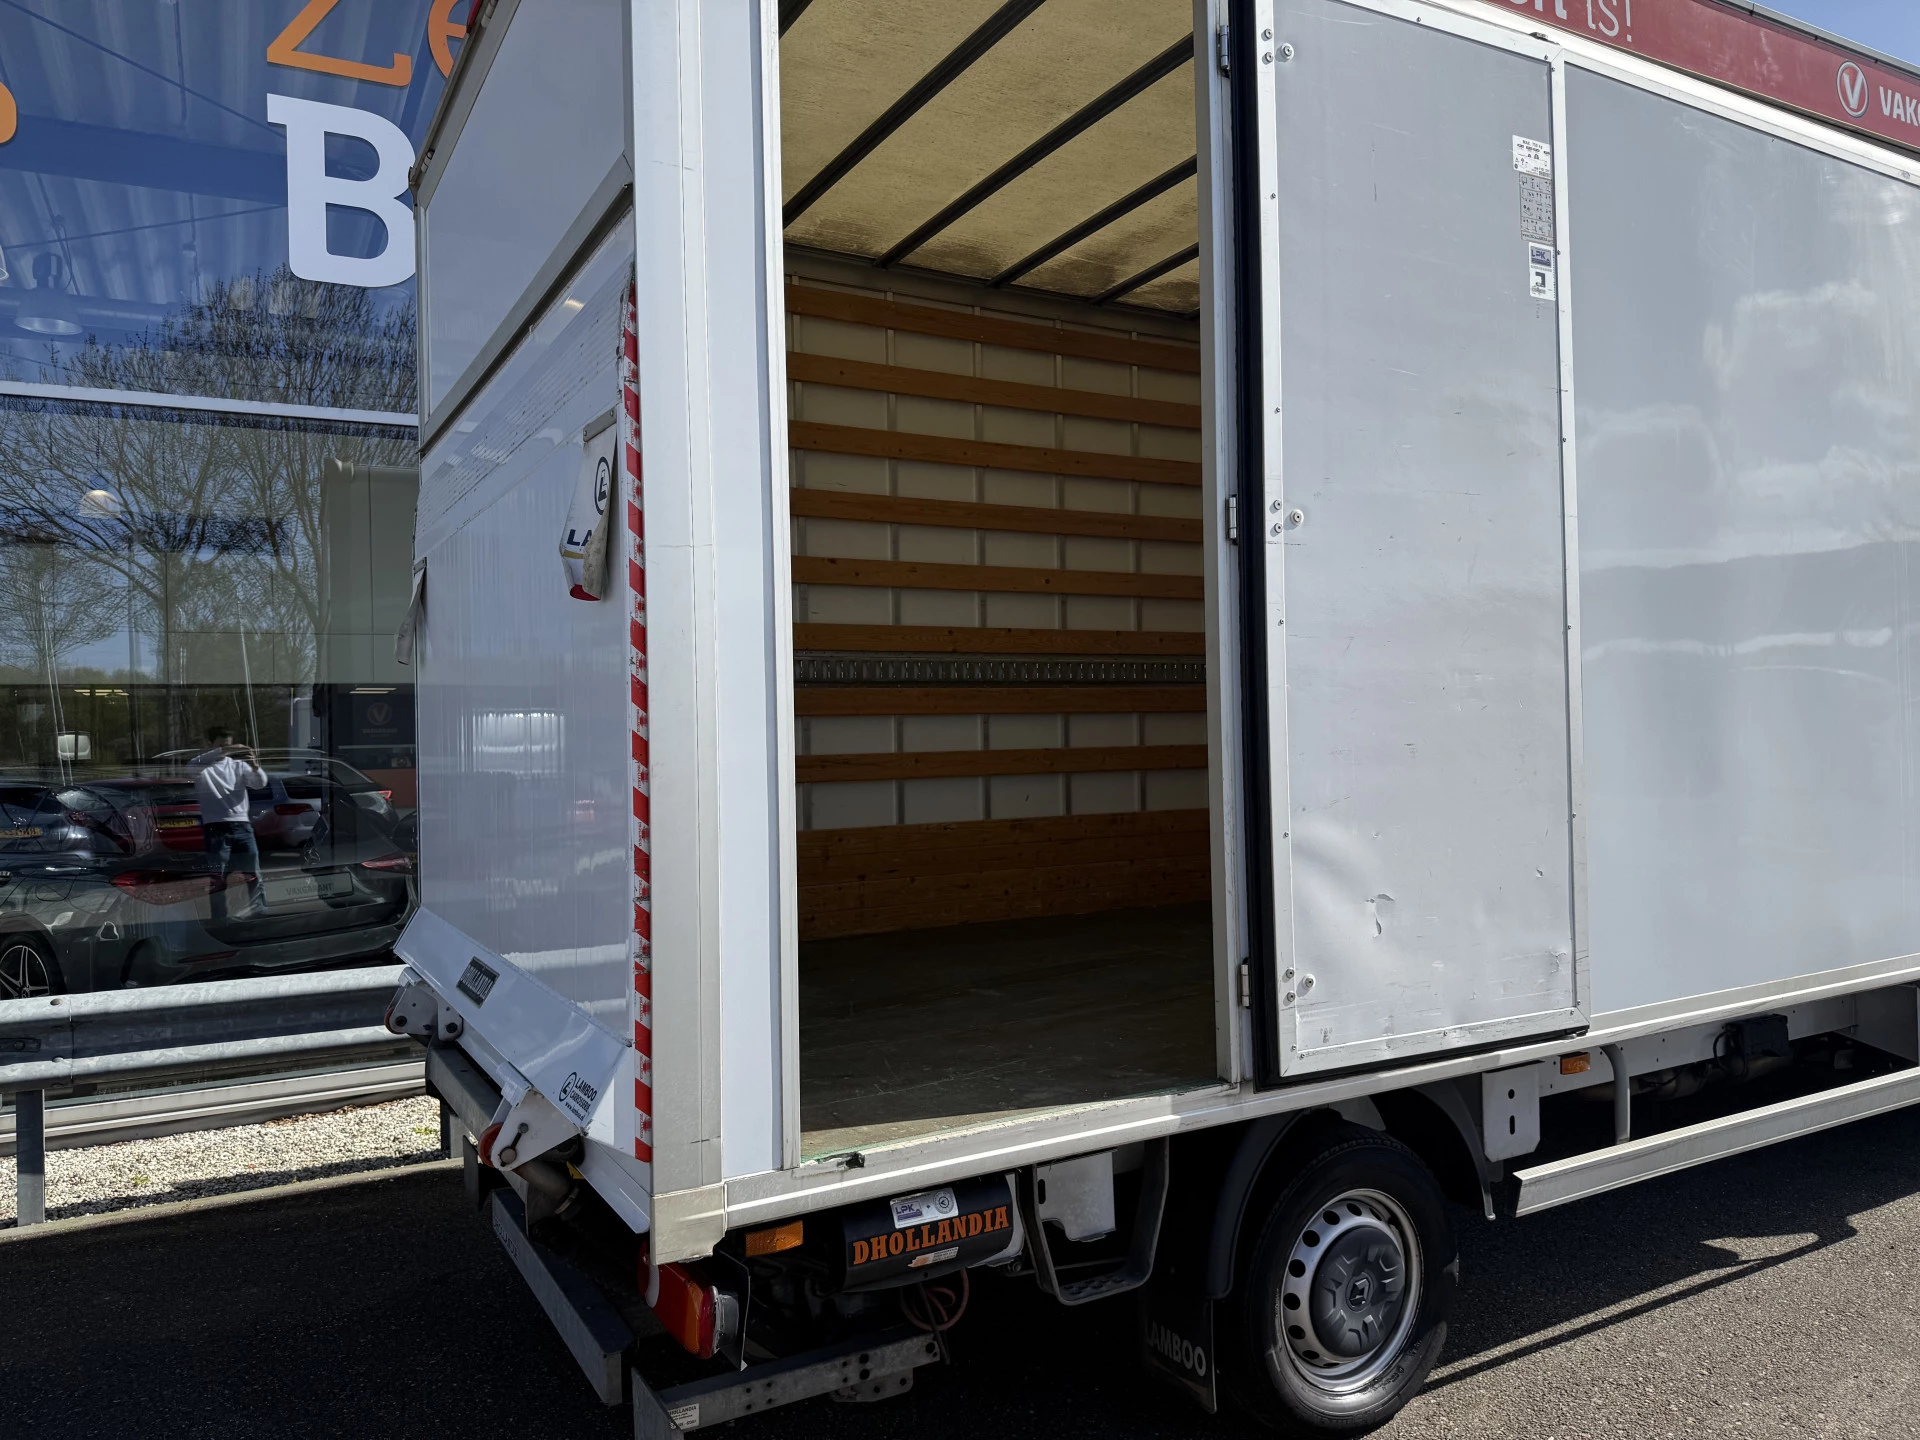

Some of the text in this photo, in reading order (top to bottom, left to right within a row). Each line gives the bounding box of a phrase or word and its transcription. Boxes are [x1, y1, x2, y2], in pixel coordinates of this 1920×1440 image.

[1879, 85, 1920, 128] VAK
[575, 1077, 598, 1102] LAMBOO
[852, 1205, 1009, 1266] DHOLLANDIA
[1144, 1315, 1207, 1377] LAMBOO
